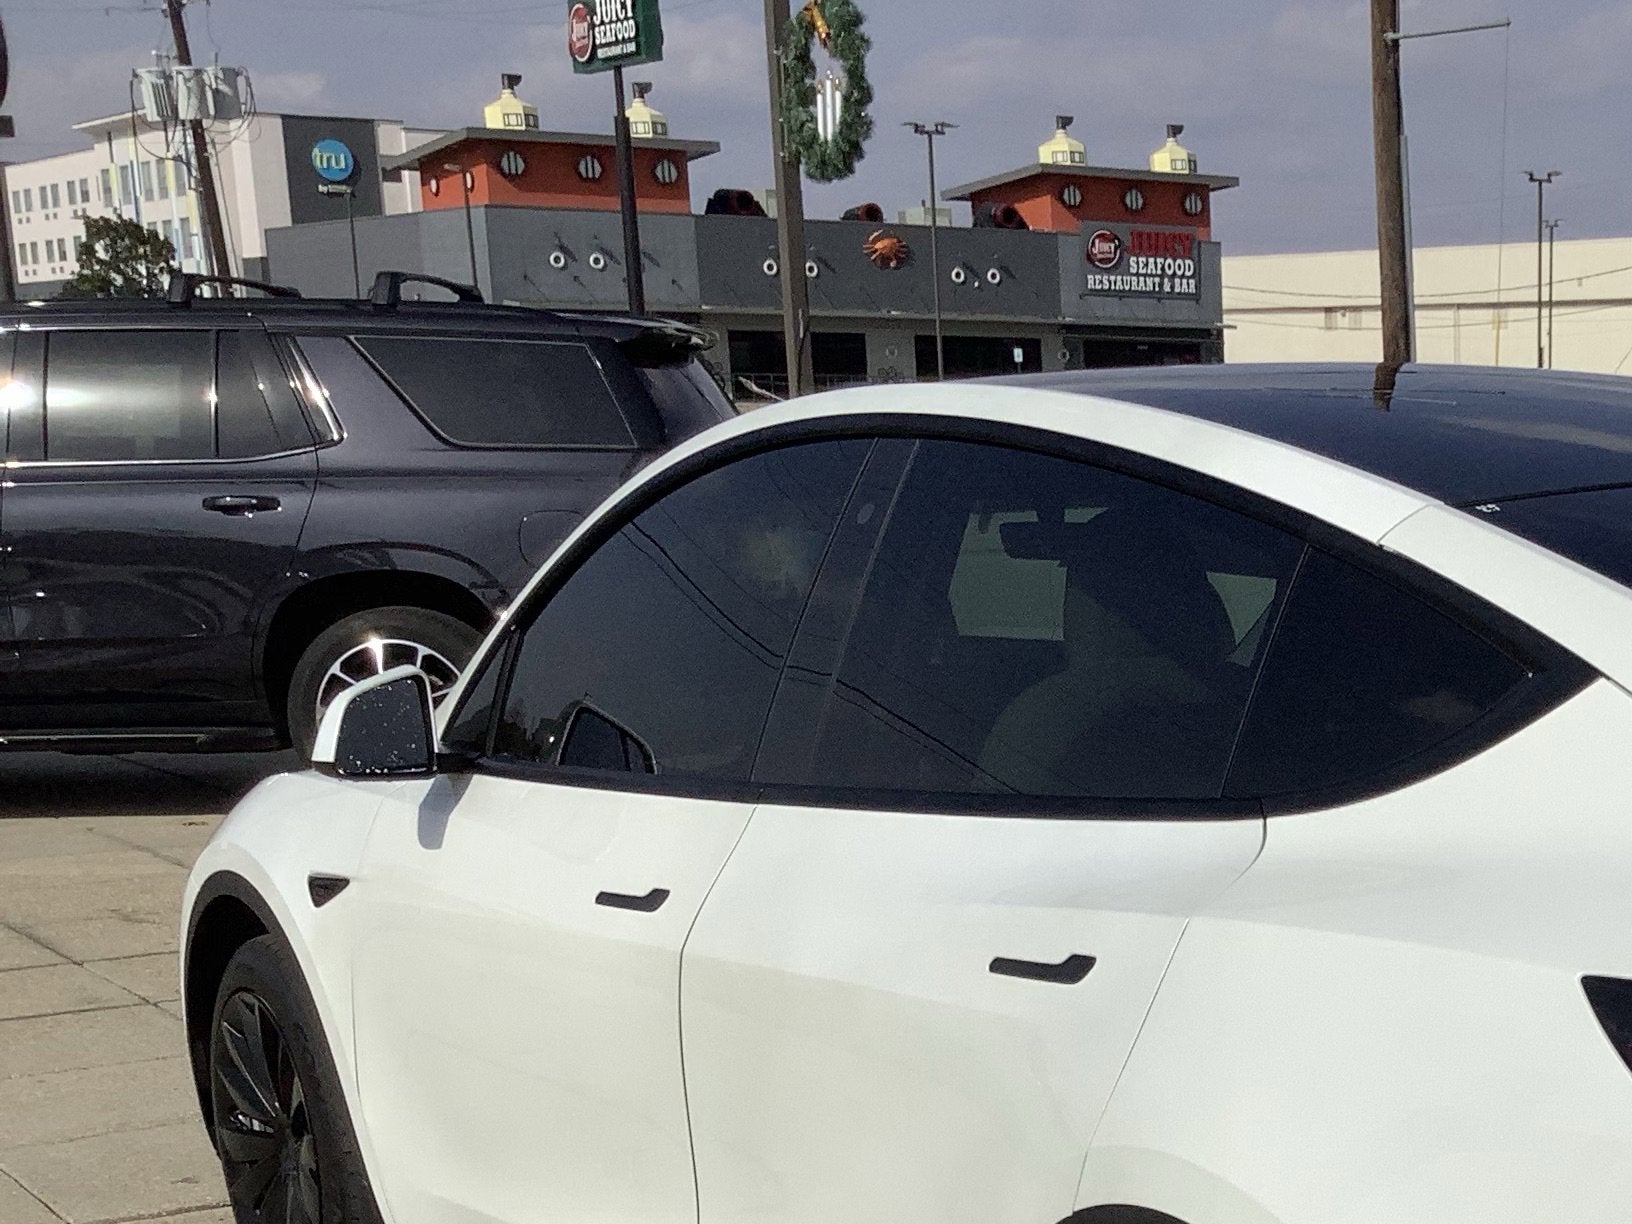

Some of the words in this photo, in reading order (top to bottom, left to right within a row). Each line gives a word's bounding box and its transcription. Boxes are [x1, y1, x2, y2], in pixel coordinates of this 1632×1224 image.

[593, 0, 633, 24] JUICY
[594, 19, 636, 45] SEAFOOD
[311, 147, 346, 169] tru
[1126, 231, 1193, 257] JUICY
[1129, 256, 1195, 276] SEAFOOD
[1087, 275, 1161, 292] RESTAURANT
[1163, 278, 1171, 292] &
[1174, 278, 1196, 294] BAR
